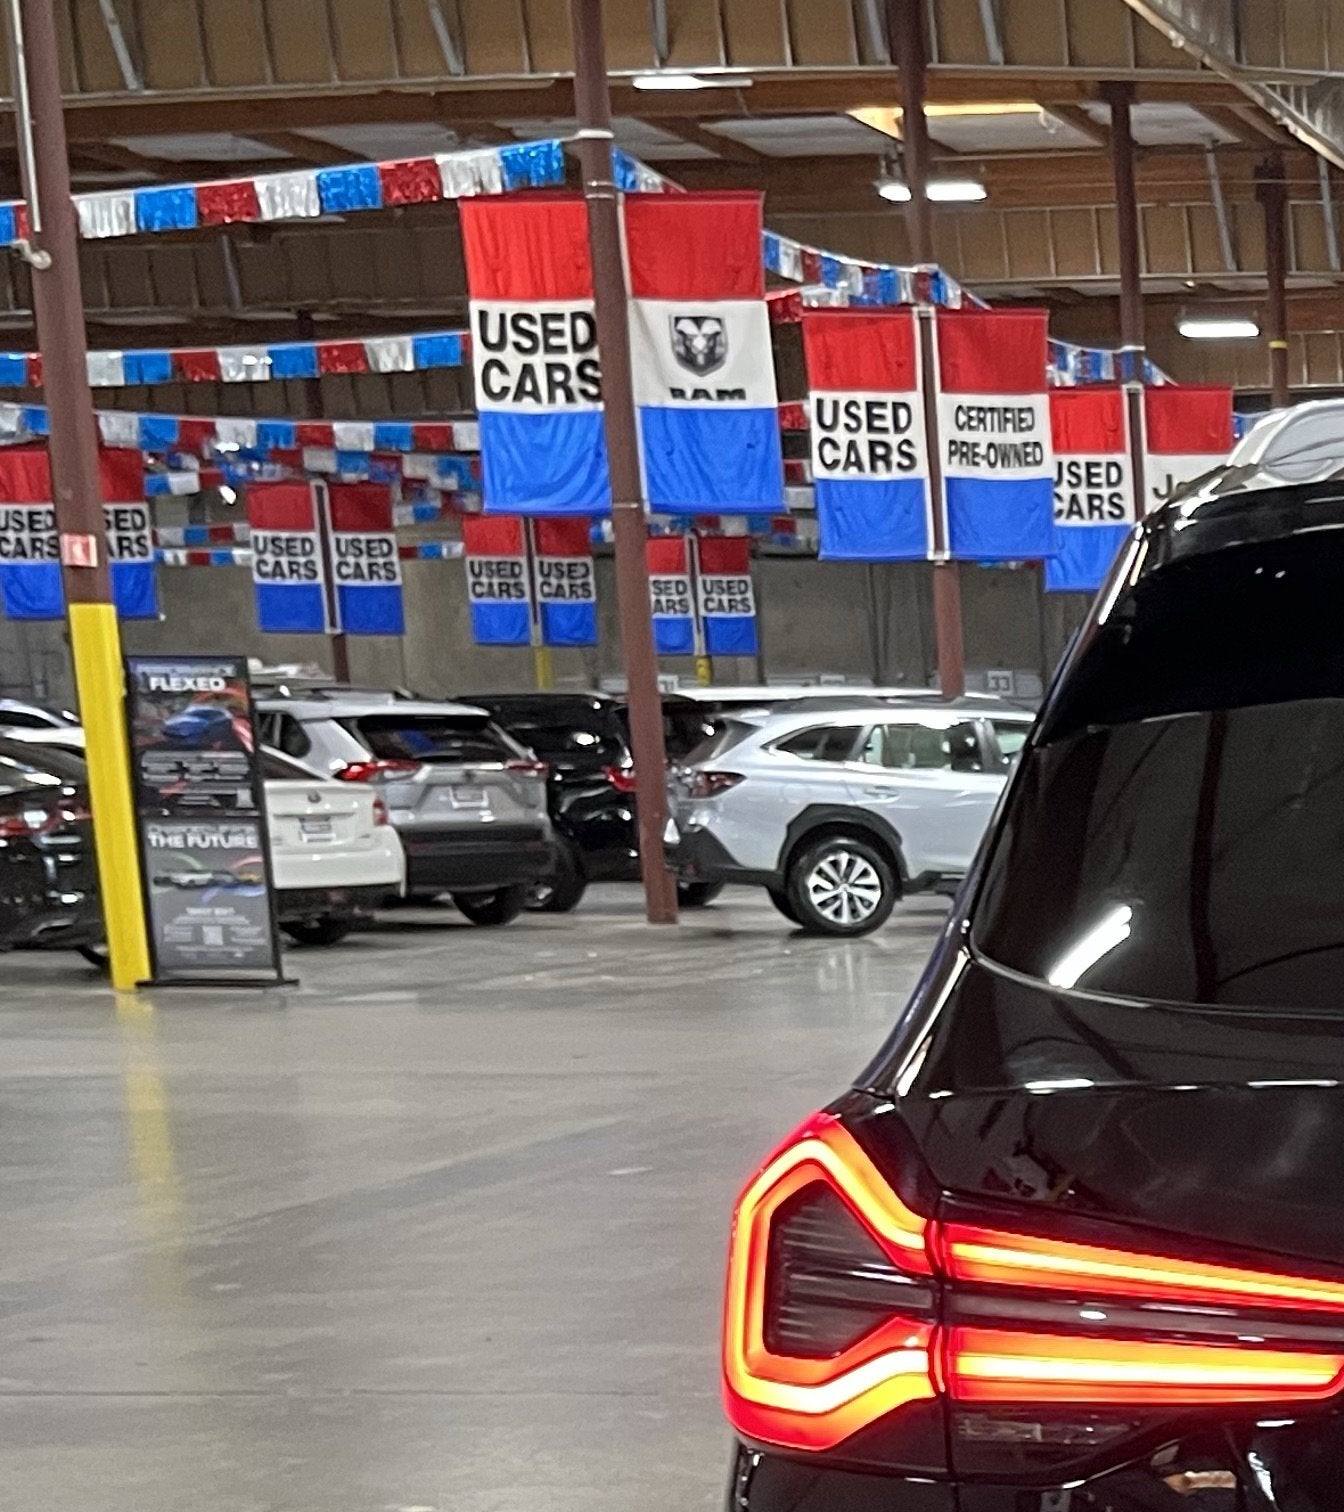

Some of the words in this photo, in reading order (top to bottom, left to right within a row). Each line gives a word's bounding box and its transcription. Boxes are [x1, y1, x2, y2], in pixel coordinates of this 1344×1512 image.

[478, 310, 597, 354] USED
[481, 358, 603, 403] CARS
[669, 387, 747, 401] RAM
[816, 398, 912, 434] USED
[955, 405, 1036, 432] CERTIFIED
[817, 436, 918, 473] CARS
[947, 438, 1044, 470] PRE-OWNED
[102, 508, 147, 532] SED
[0, 536, 60, 560] CARS
[253, 535, 315, 557] USED
[335, 537, 394, 558] USED
[255, 559, 318, 580] CARS
[335, 561, 397, 581] CARS
[469, 560, 522, 579] USED
[538, 561, 590, 580] USED
[471, 581, 526, 599] CARS
[539, 581, 592, 599] CARS
[652, 579, 688, 596] SED
[702, 579, 749, 596] USED
[653, 598, 690, 614] ARS
[703, 597, 752, 614] CARS
[149, 676, 227, 692] FLEXED
[148, 832, 185, 848] THE
[187, 832, 258, 849] FUTURE
